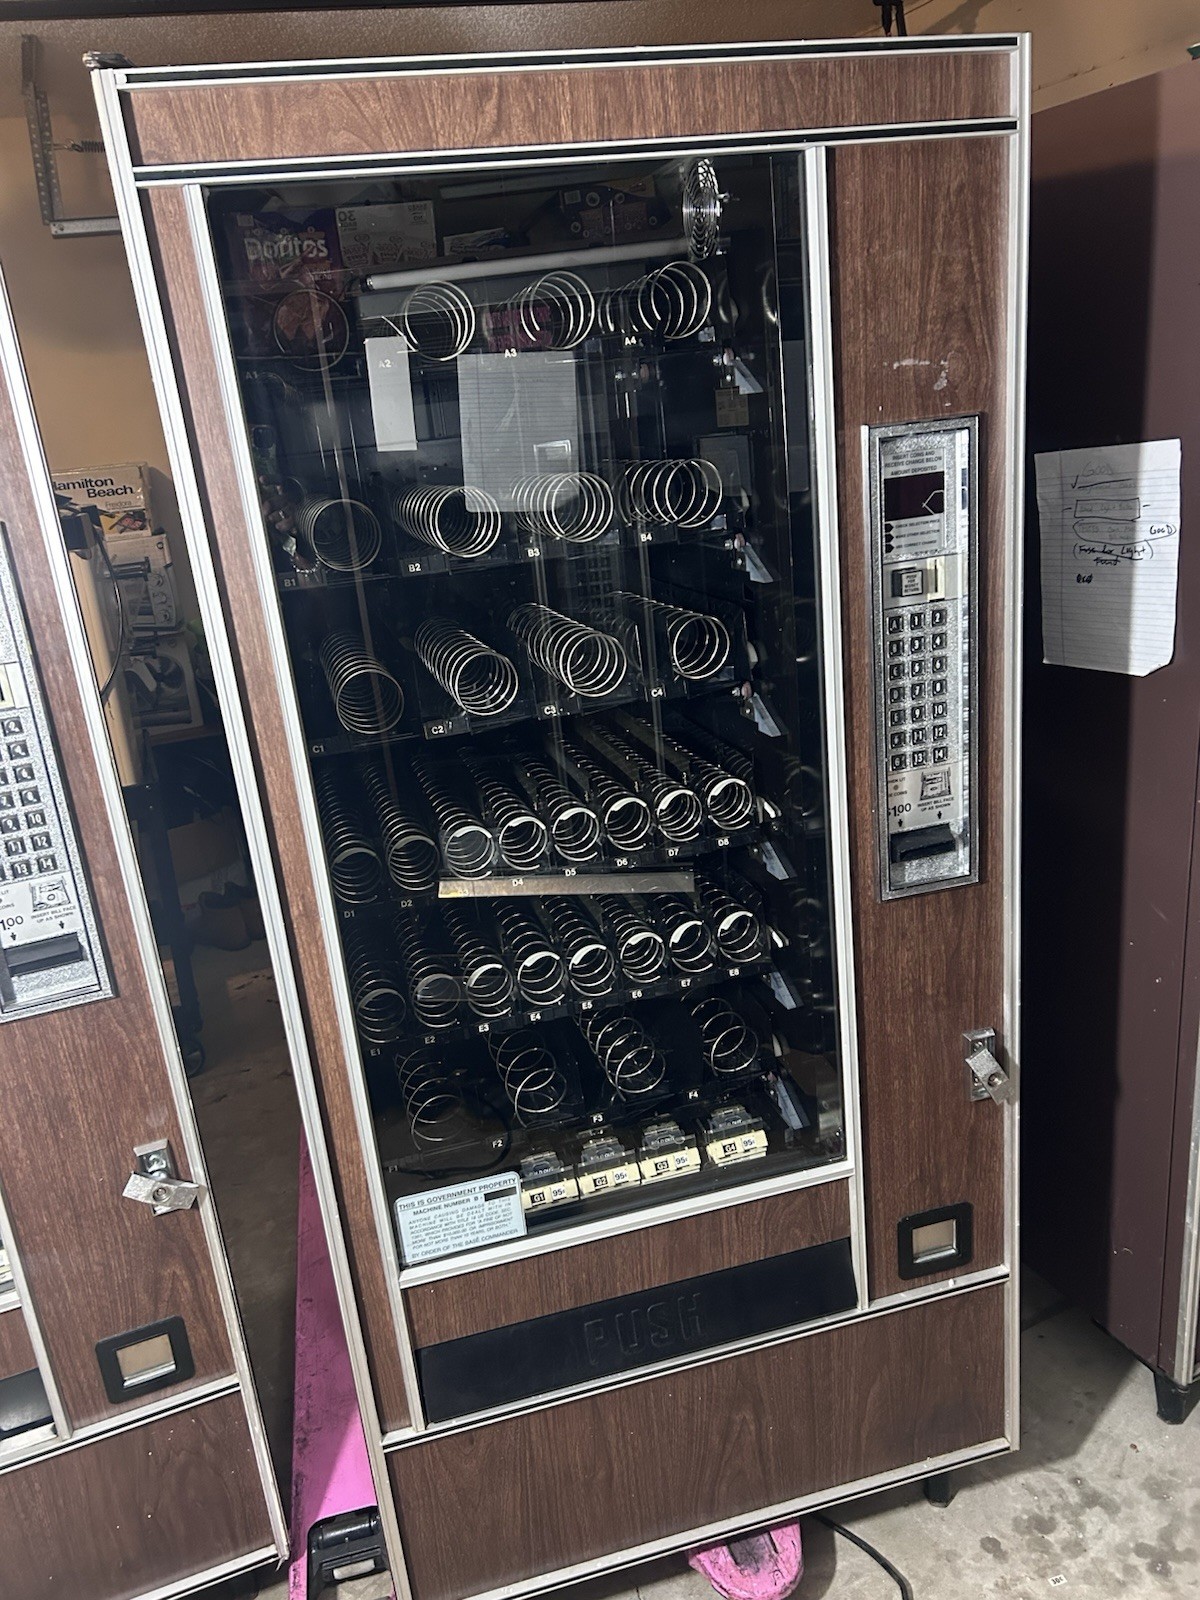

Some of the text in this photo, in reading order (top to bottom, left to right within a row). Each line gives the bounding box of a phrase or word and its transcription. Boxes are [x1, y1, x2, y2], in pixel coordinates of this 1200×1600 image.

[244, 235, 328, 260] Doritos
[624, 336, 637, 345] A4
[504, 349, 517, 358] A3
[378, 359, 392, 368] A2
[911, 465, 937, 473] DEPOSITED
[87, 485, 134, 498] Beach
[640, 533, 652, 542] B4
[527, 548, 540, 557] B3
[408, 563, 422, 572] B2
[284, 578, 296, 587] B1
[651, 687, 663, 697] C4
[544, 705, 557, 715] C3
[934, 704, 943, 715] 10
[431, 725, 445, 735] C2
[935, 727, 943, 737] 12
[914, 730, 923, 742] 11
[312, 744, 325, 753] C1
[914, 752, 923, 763] 13
[935, 749, 943, 759] 14
[29, 813, 41, 824] 10
[34, 836, 48, 847] 12
[717, 838, 729, 847] D8
[9, 841, 22, 852] 11
[668, 848, 679, 857] D7
[41, 858, 54, 869] 14
[616, 859, 628, 867] D6
[14, 863, 28, 874] 13
[565, 868, 577, 877] D5
[511, 878, 524, 887] D4
[400, 899, 413, 908] D2
[54, 911, 74, 919] SHOWN
[344, 910, 355, 918] D1
[729, 968, 740, 976] E8
[681, 979, 691, 987] E7
[631, 990, 643, 998] E6
[581, 1001, 593, 1010] E5
[530, 1012, 541, 1021] E4
[478, 1024, 490, 1033] E3
[424, 1036, 436, 1044] E2
[370, 1048, 381, 1056] E1
[688, 1090, 699, 1099] F4
[592, 1114, 604, 1123] F3
[492, 1139, 503, 1148] F2
[725, 1143, 736, 1151] G4
[388, 1164, 398, 1173] F1
[657, 1161, 668, 1170] G3
[595, 1177, 607, 1185] G2
[399, 1201, 415, 1210] THIS
[427, 1187, 476, 1204] GOVERNMENT
[479, 1177, 516, 1191] PROPERTY
[533, 1192, 544, 1202] G1
[413, 1198, 471, 1216] MACHINE NUMBER
[462, 1203, 485, 1212] DAMAGE
[409, 1220, 436, 1230] MACHINE
[466, 1208, 485, 1216] DEALT
[478, 1216, 513, 1228] IMPRISONMENT
[410, 1224, 442, 1235] ACCORDANCE
[421, 1247, 441, 1256] ORDER
[481, 1228, 518, 1241] COMMANDER
[584, 1292, 705, 1366] PUSH
